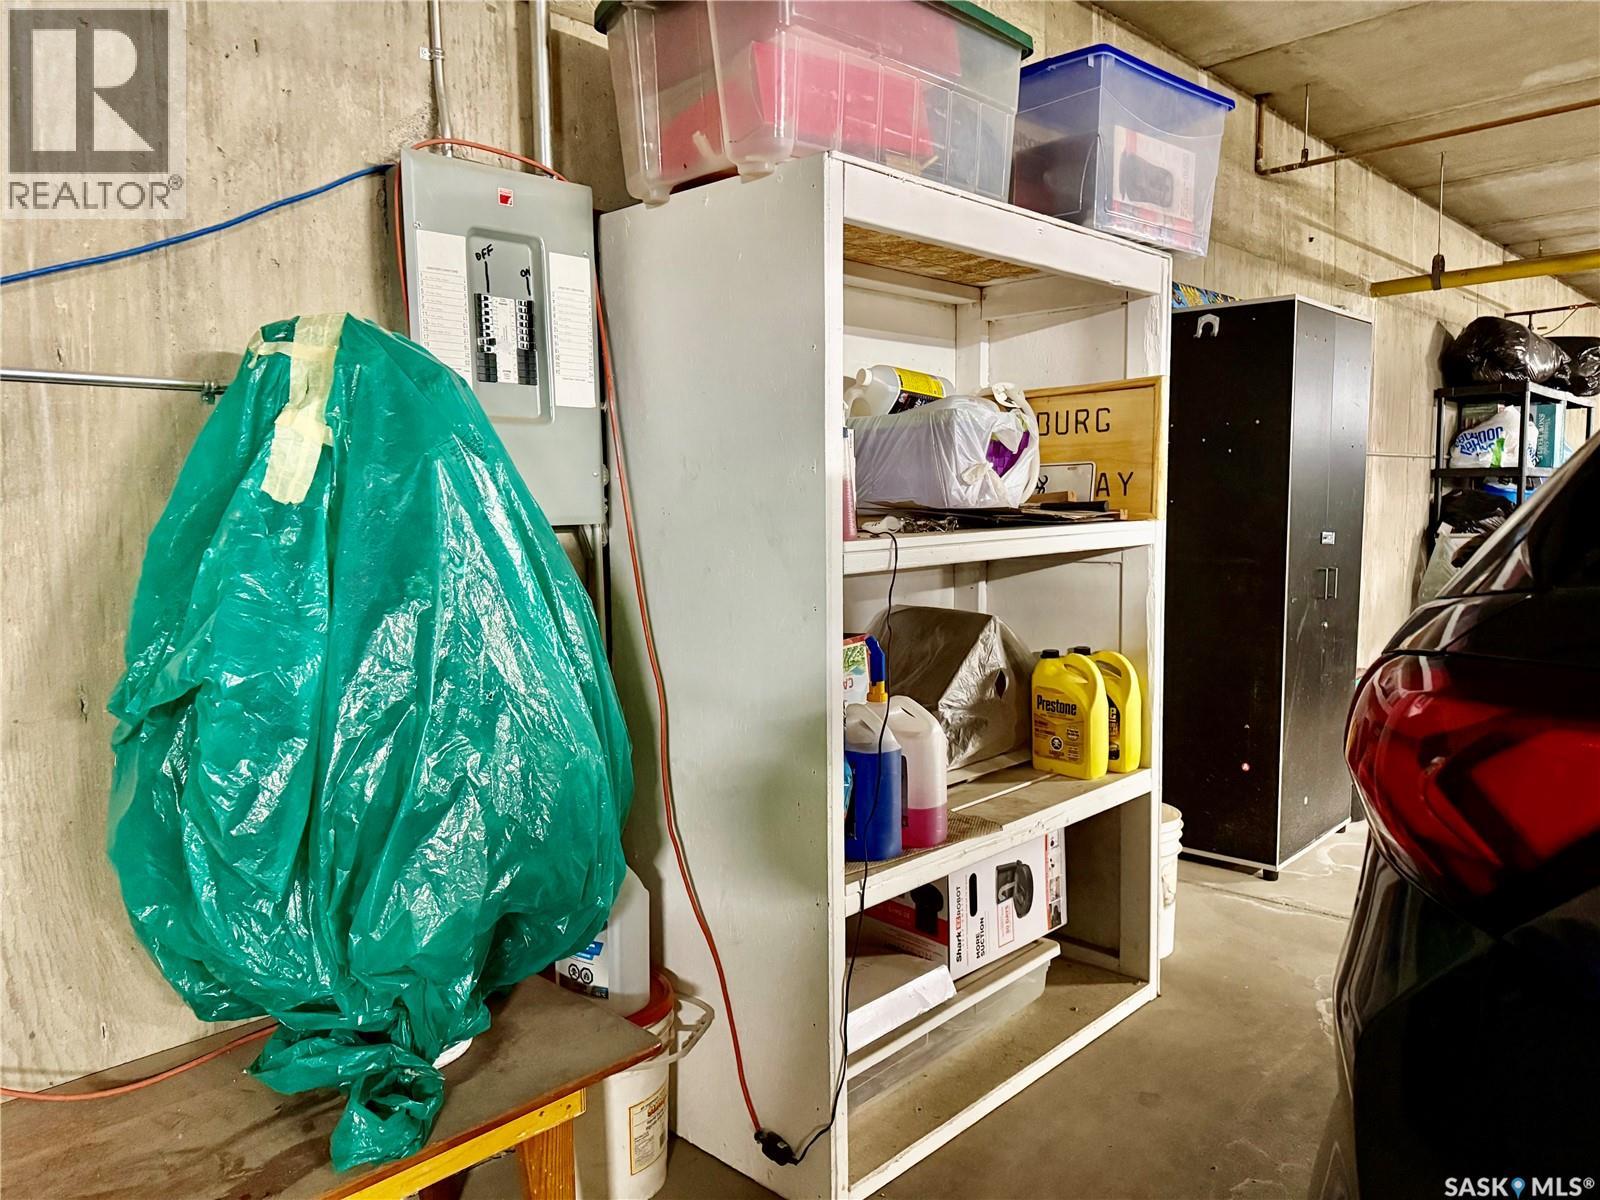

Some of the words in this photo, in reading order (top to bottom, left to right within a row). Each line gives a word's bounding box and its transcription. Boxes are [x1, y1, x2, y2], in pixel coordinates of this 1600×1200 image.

[474, 243, 494, 262] OFF
[1036, 694, 1078, 717] Prestone
[955, 931, 963, 963] Shark
